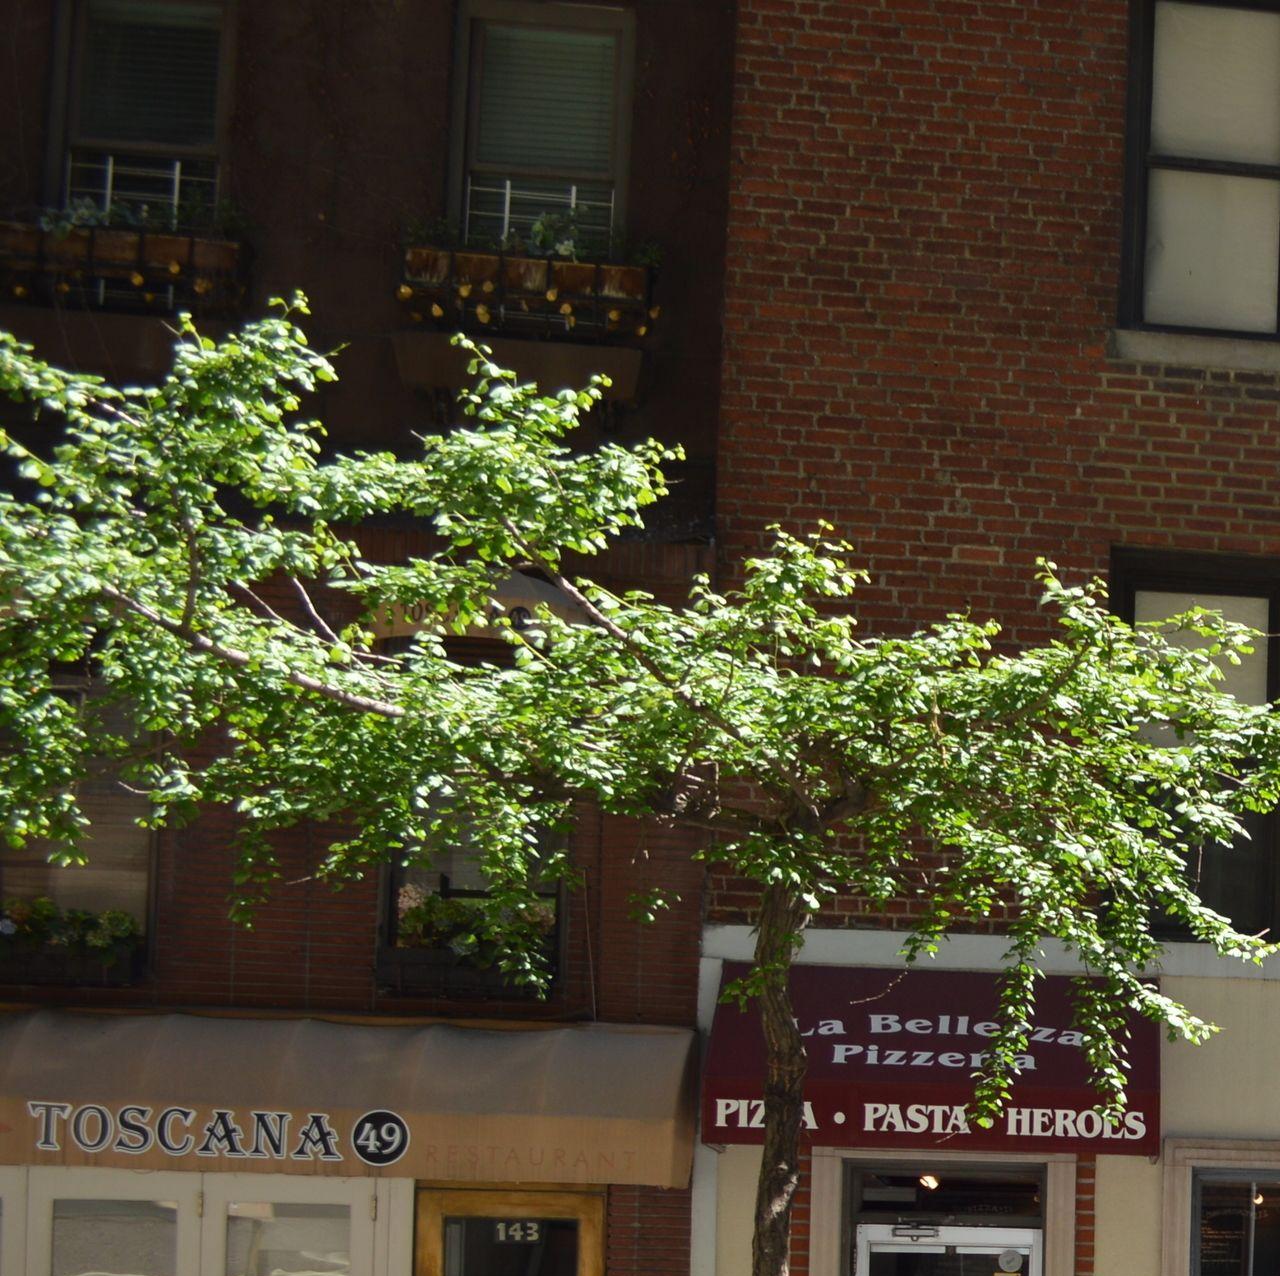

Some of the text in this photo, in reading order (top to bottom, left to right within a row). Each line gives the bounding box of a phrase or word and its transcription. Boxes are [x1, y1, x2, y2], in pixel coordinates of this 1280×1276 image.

[27, 1101, 401, 1161] TOSCANA 49
[715, 1098, 1147, 1140] PIZA PASTA HEROES
[426, 1145, 638, 1170] RESTAURANT
[496, 1223, 540, 1242] 143
